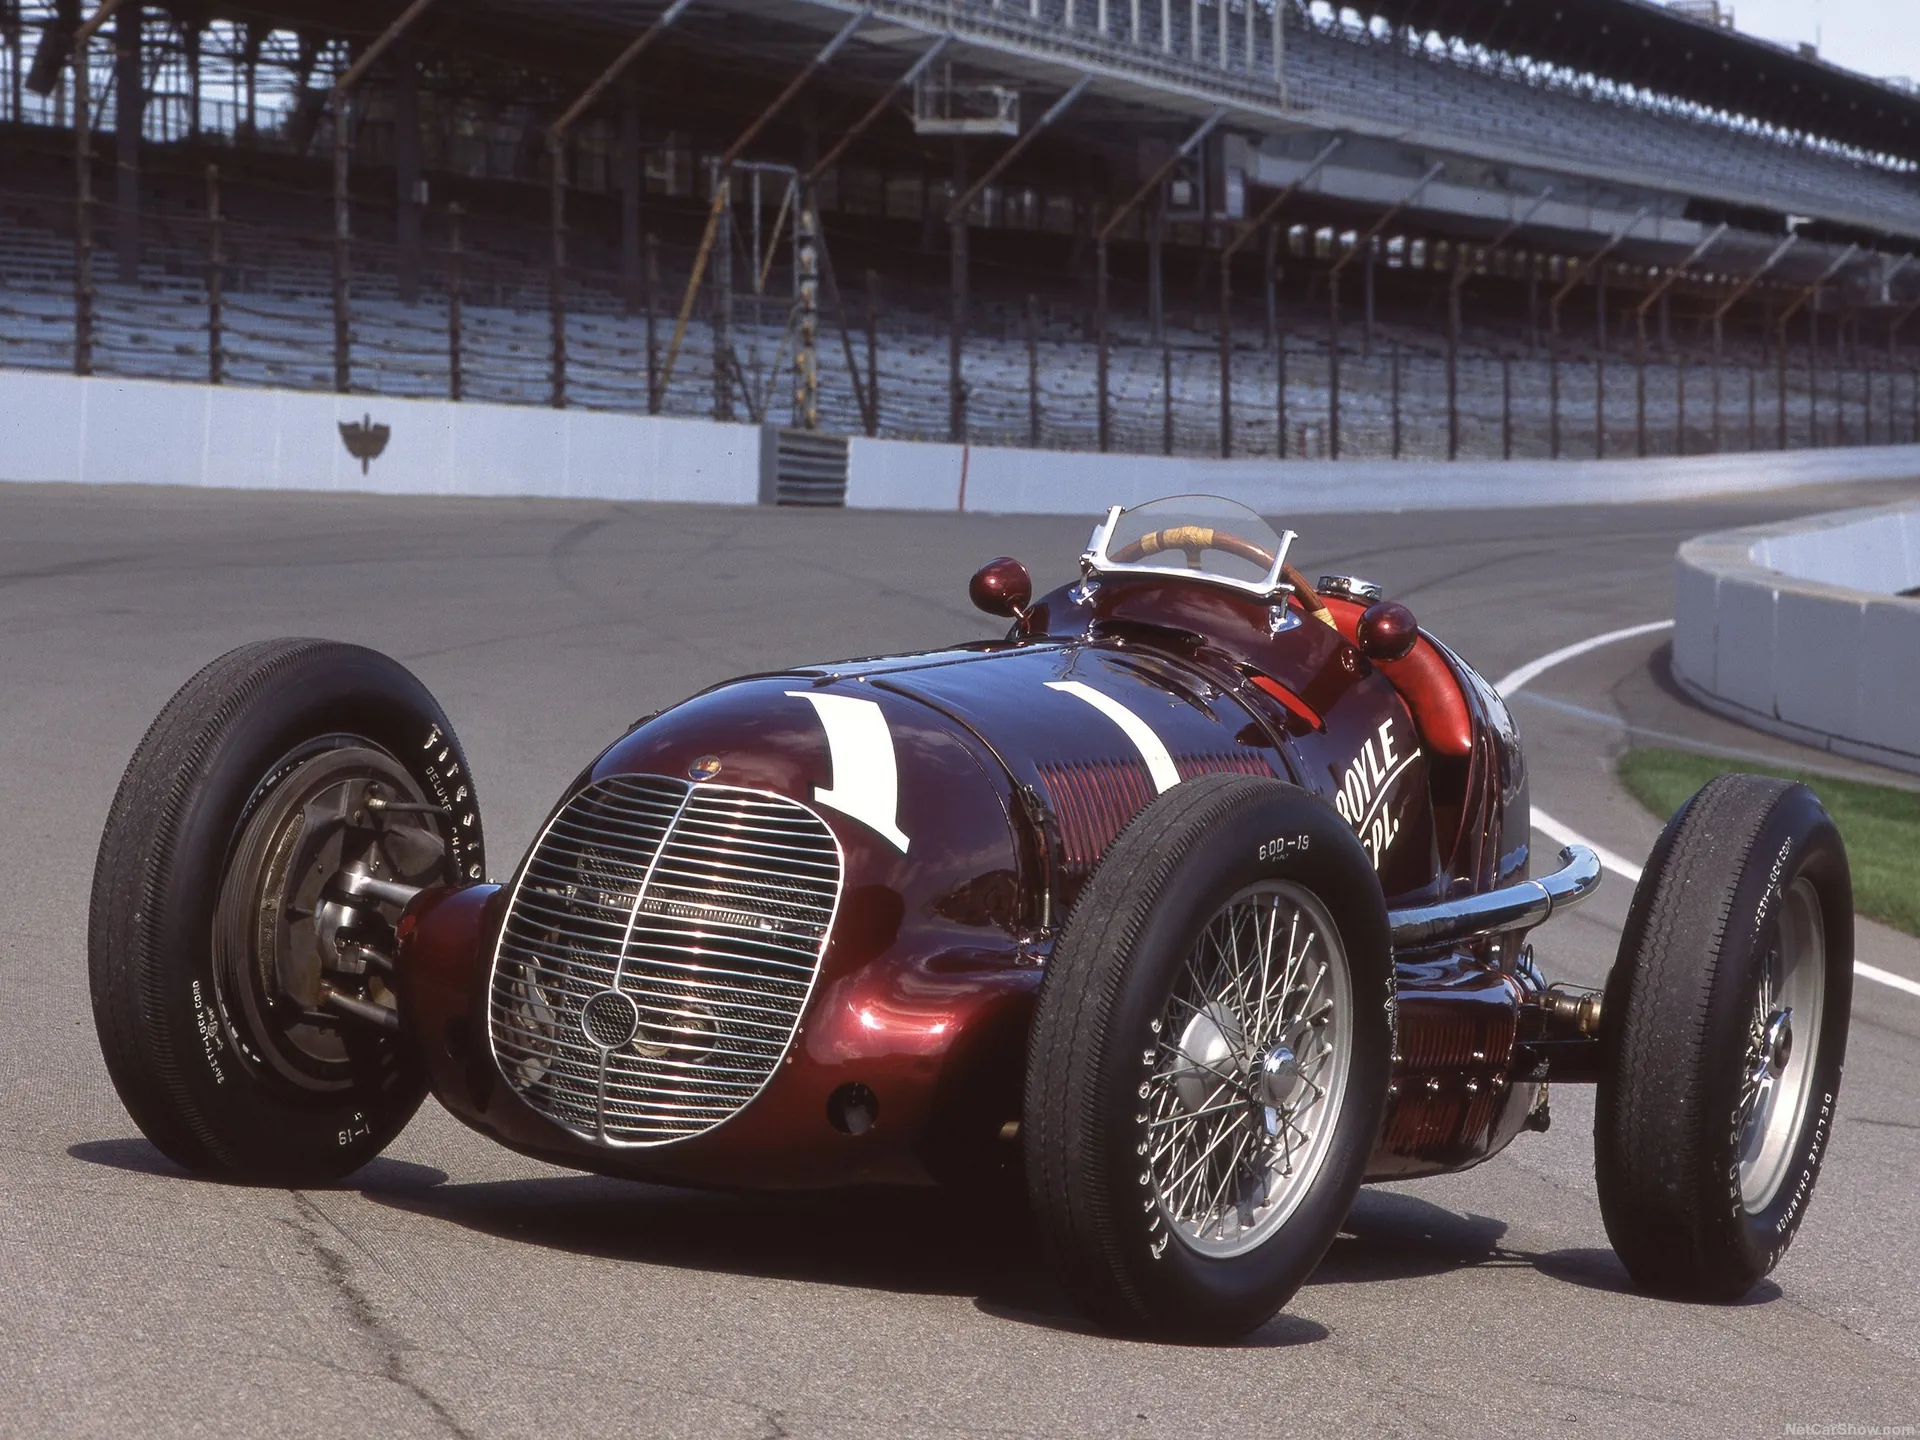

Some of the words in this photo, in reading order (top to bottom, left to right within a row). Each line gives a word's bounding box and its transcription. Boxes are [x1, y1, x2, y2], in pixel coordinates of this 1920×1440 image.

[425, 766, 452, 812] DELUXE
[784, 691, 910, 854] 1
[1335, 717, 1398, 826] BOYLE
[192, 980, 202, 1008] CORD
[1136, 1019, 1168, 1259] Firestone
[1808, 1093, 1832, 1165] DELUXE
[1775, 1170, 1811, 1234] CHAMPION
